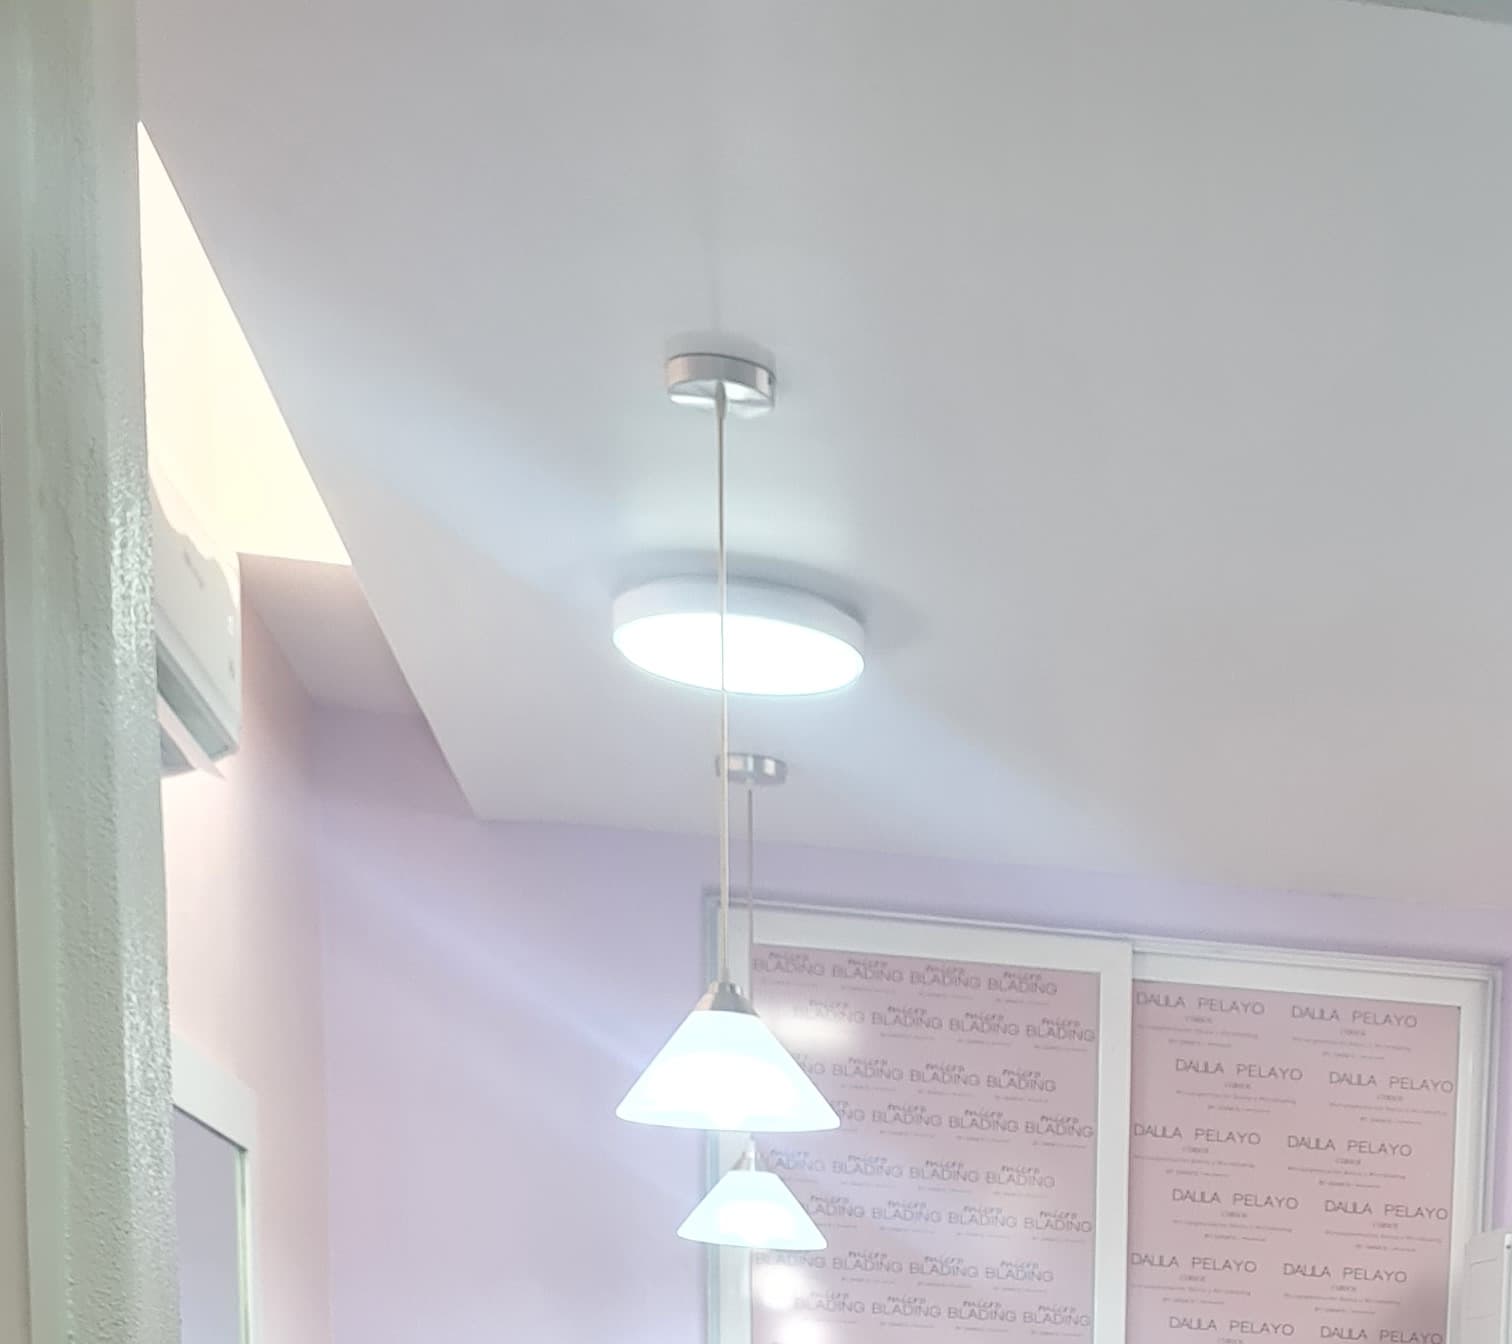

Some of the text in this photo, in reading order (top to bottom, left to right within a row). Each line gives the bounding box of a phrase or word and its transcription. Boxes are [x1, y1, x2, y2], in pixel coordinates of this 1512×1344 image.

[753, 959, 1058, 996] BLADING BLADING BLADING BLADING
[832, 1065, 1056, 1092] BLADING BLADING BLADING
[1236, 1064, 1303, 1081] PELAYO
[1389, 1076, 1454, 1093] PELAYO
[1232, 1192, 1299, 1211] PELAYO
[1385, 1204, 1448, 1221] PELAYO
[1229, 1321, 1295, 1337] PELAYO
